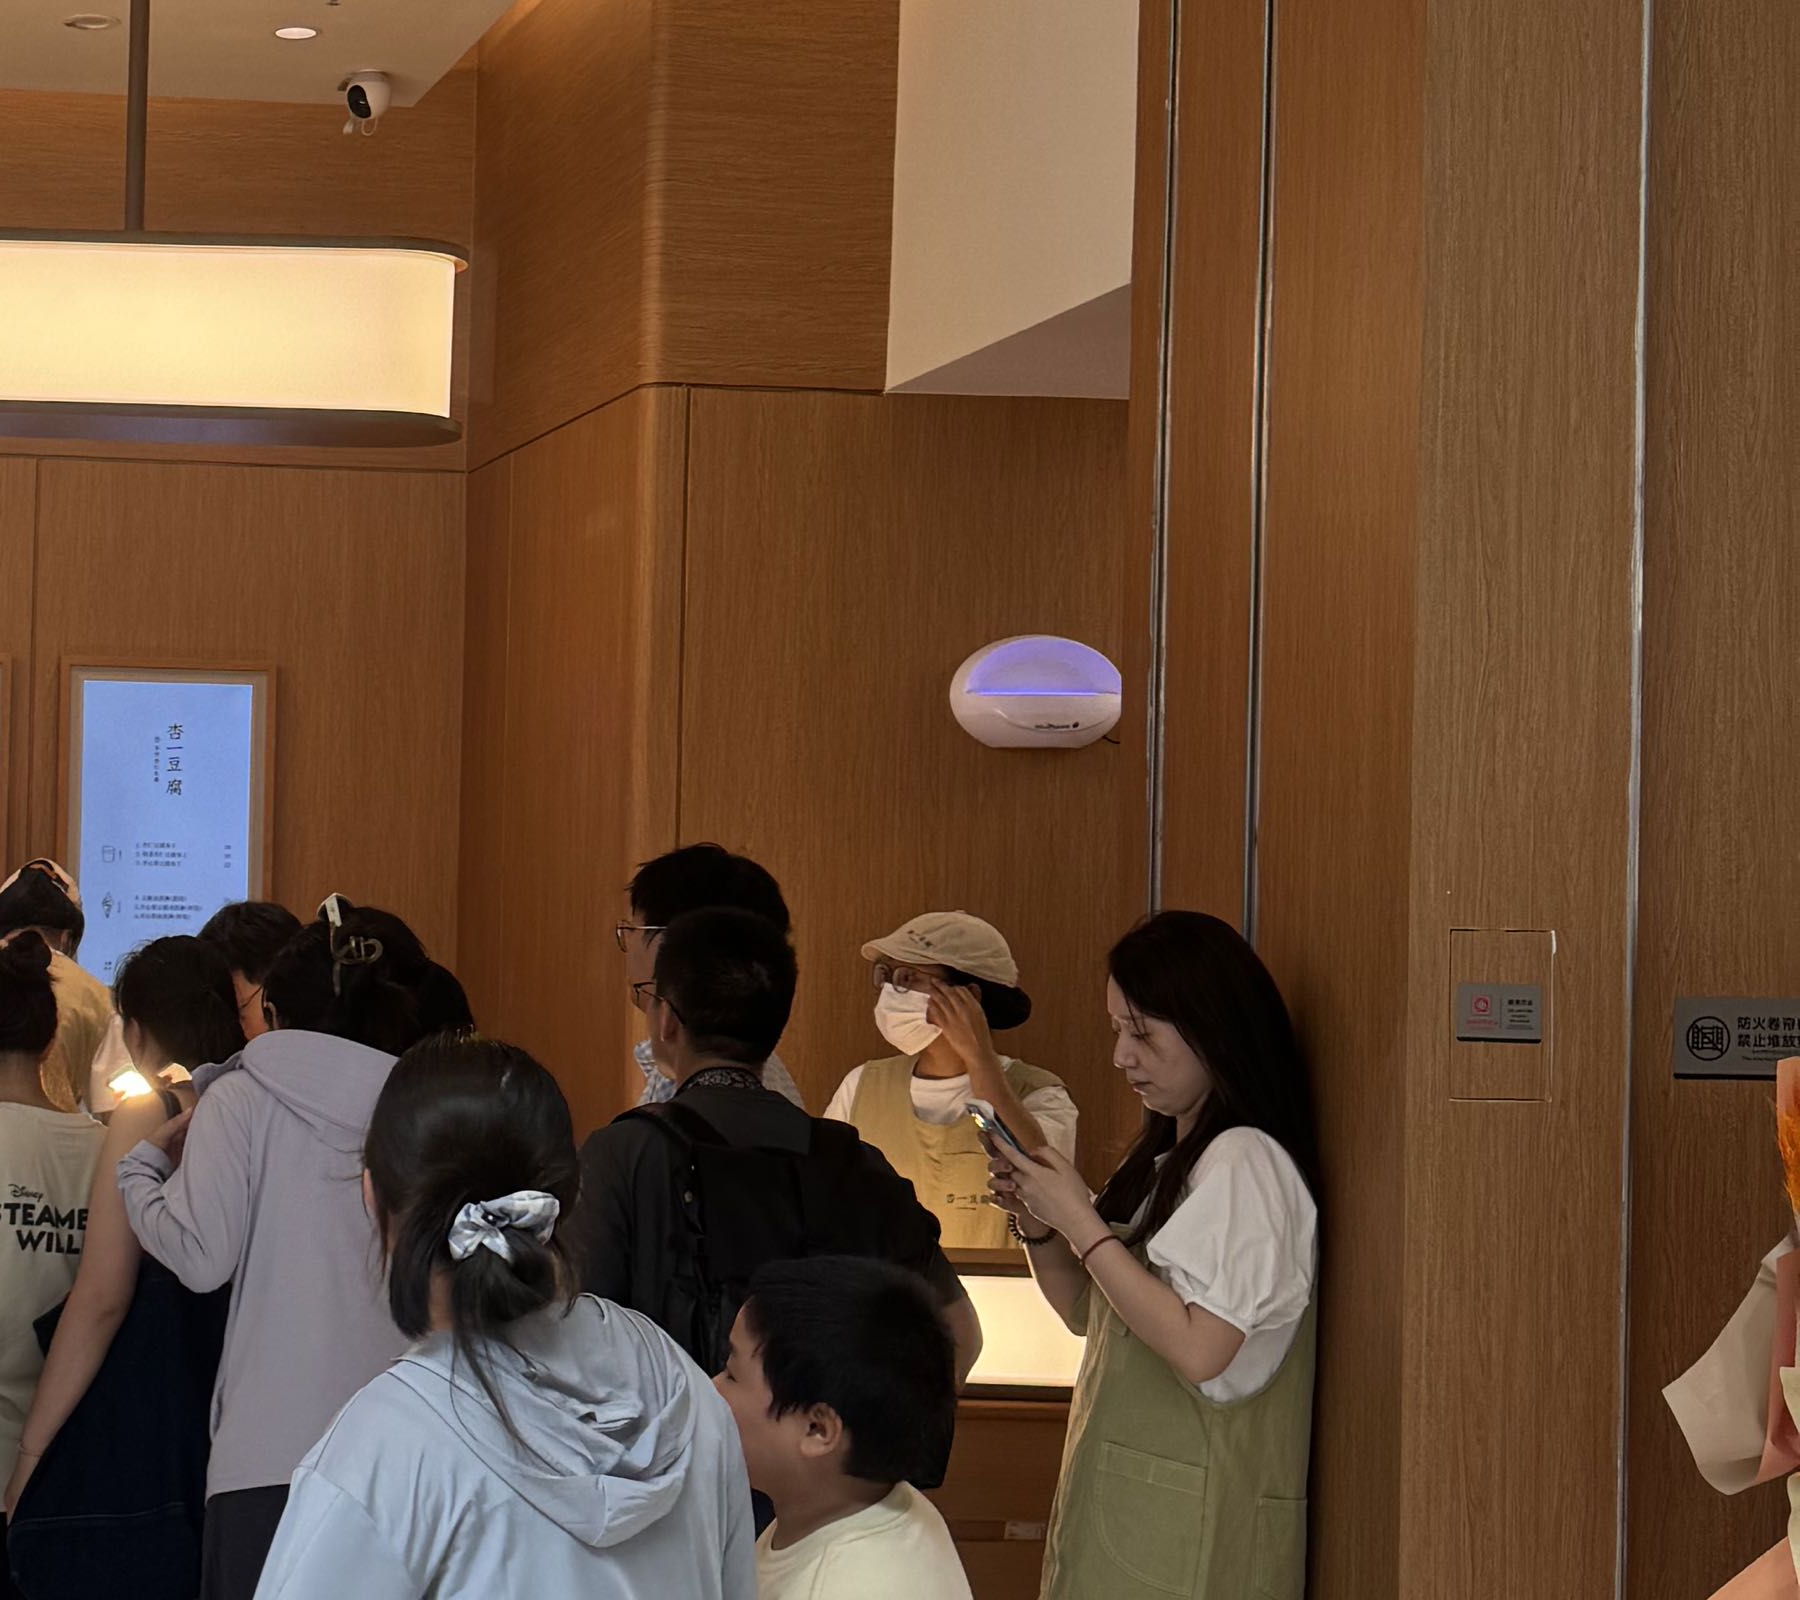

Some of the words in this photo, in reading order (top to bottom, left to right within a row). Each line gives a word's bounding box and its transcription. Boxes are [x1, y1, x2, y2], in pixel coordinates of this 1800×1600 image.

[166, 723, 184, 796] 杏一豆腐
[1737, 1016, 1800, 1031] 防火卷帘
[1737, 1033, 1800, 1048] 禁止堆放
[8, 1183, 44, 1203] Disney
